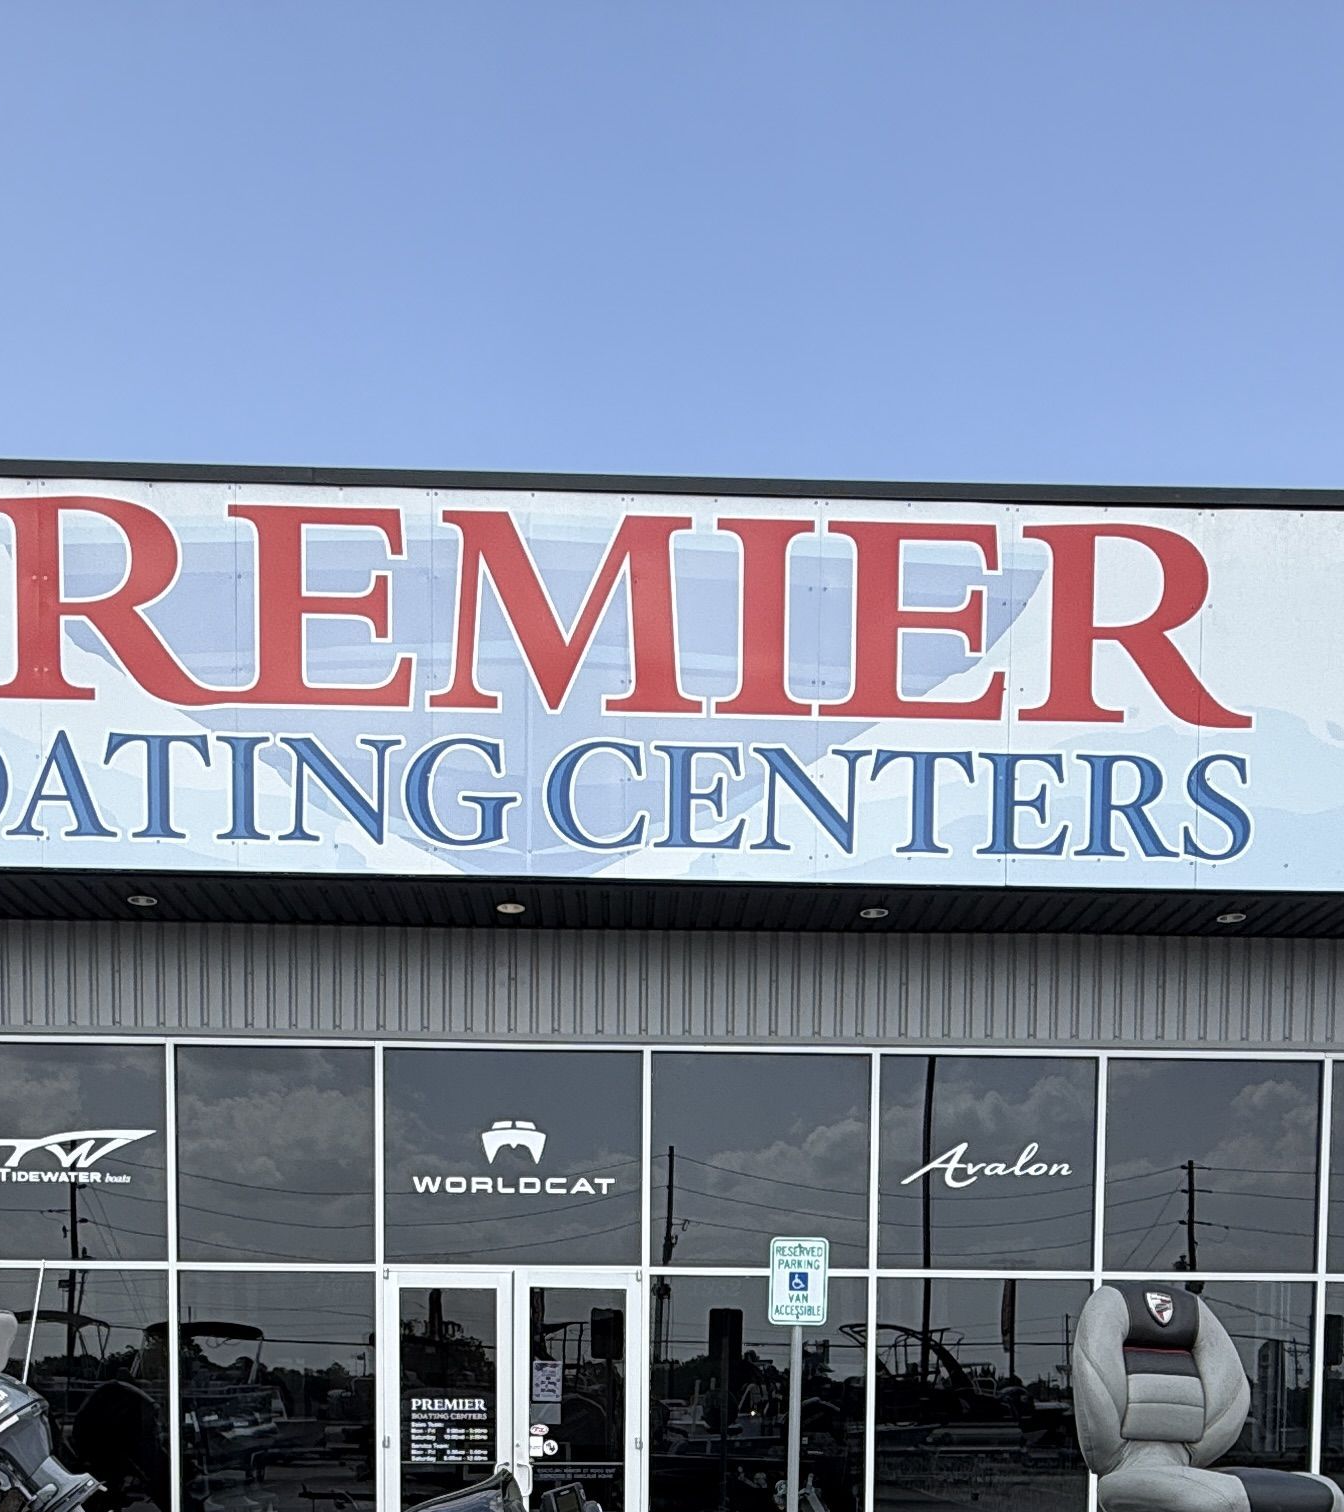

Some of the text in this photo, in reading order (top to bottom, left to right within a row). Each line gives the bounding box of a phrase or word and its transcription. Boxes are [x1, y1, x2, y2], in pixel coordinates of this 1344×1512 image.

[545, 739, 1253, 862] CENTERS
[900, 1142, 1073, 1188] Avalon
[104, 1172, 132, 1184] boats
[412, 1176, 616, 1194] WORLDCAT
[776, 1246, 823, 1257] RESERVED
[778, 1259, 820, 1270] PARKING
[788, 1293, 809, 1303] VAN
[774, 1305, 821, 1316] ACCESSIBLE
[411, 1398, 487, 1411] PREMIER
